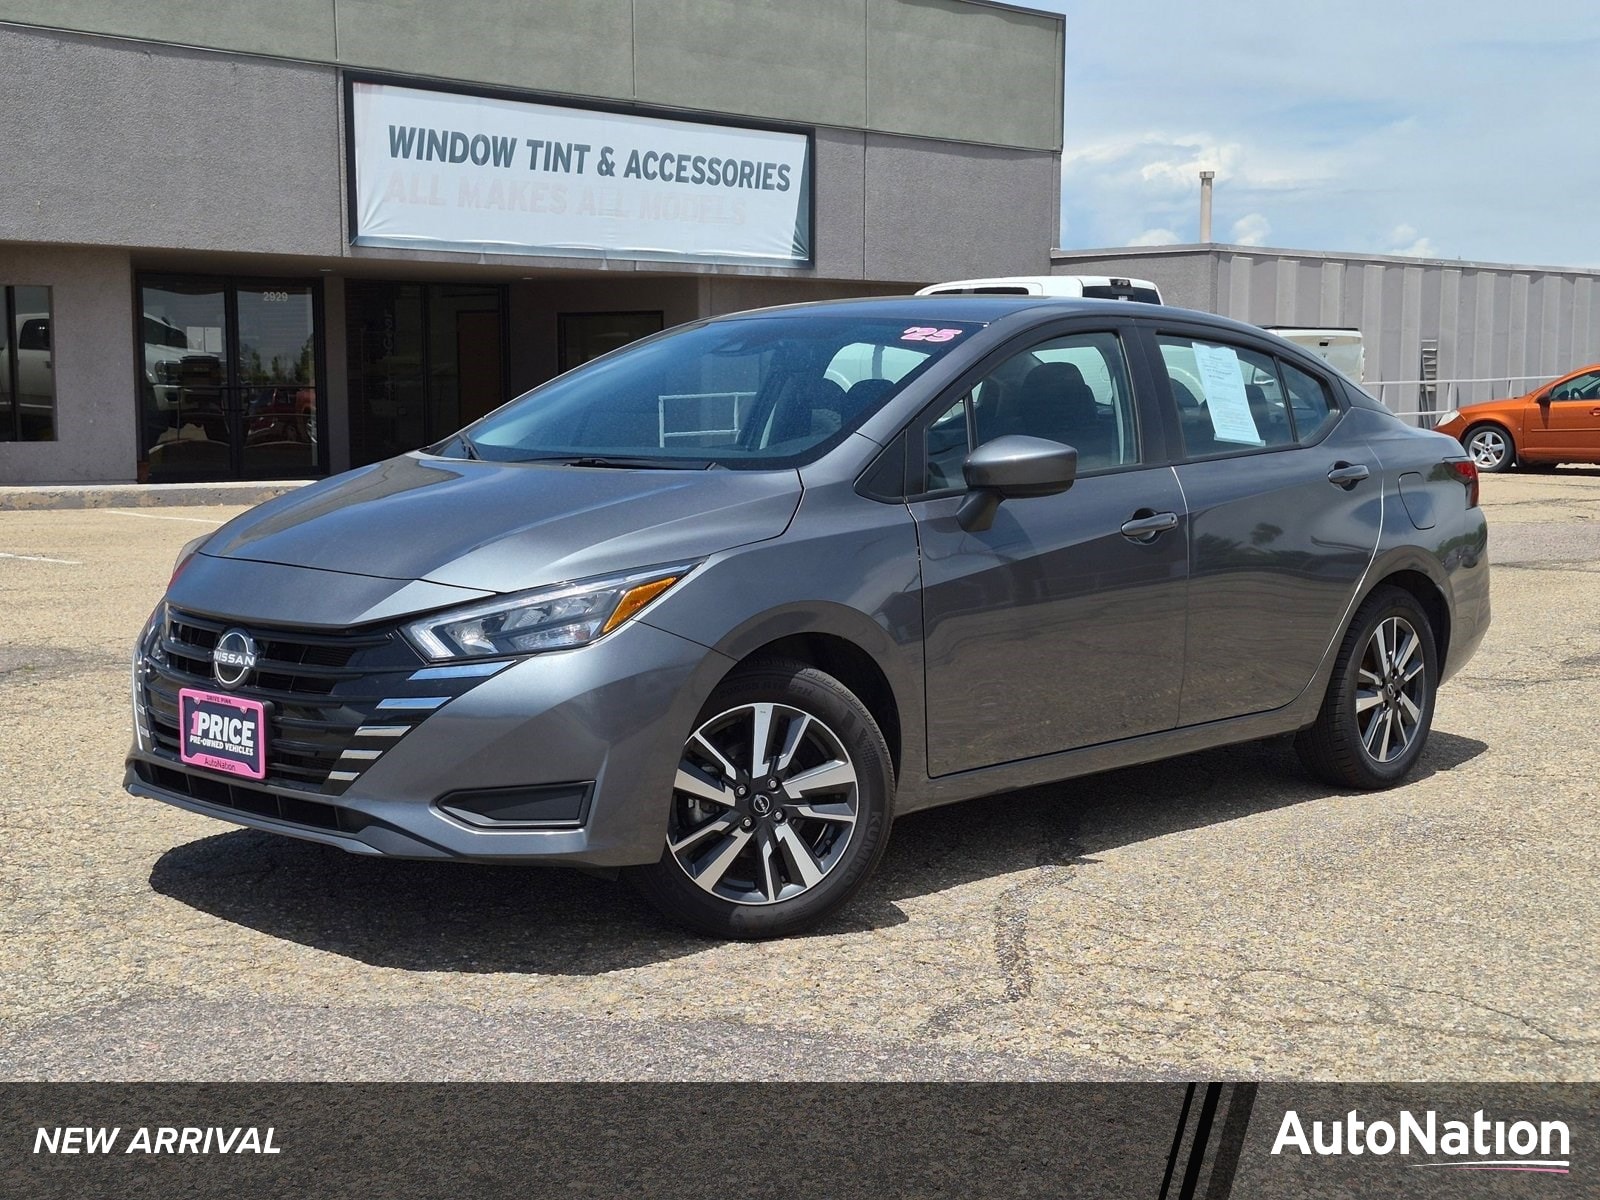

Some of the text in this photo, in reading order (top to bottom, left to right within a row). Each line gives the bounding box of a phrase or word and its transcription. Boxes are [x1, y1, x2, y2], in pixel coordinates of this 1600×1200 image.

[388, 124, 791, 192] WINDOW TINT & ACCESSORIES
[383, 168, 447, 206] ALL
[456, 174, 569, 216] MAKES
[263, 291, 289, 302] 2929
[213, 650, 255, 666] NISSAN
[189, 734, 254, 756] PRE-OWNED VEHICLES
[204, 757, 236, 772] AutoNation
